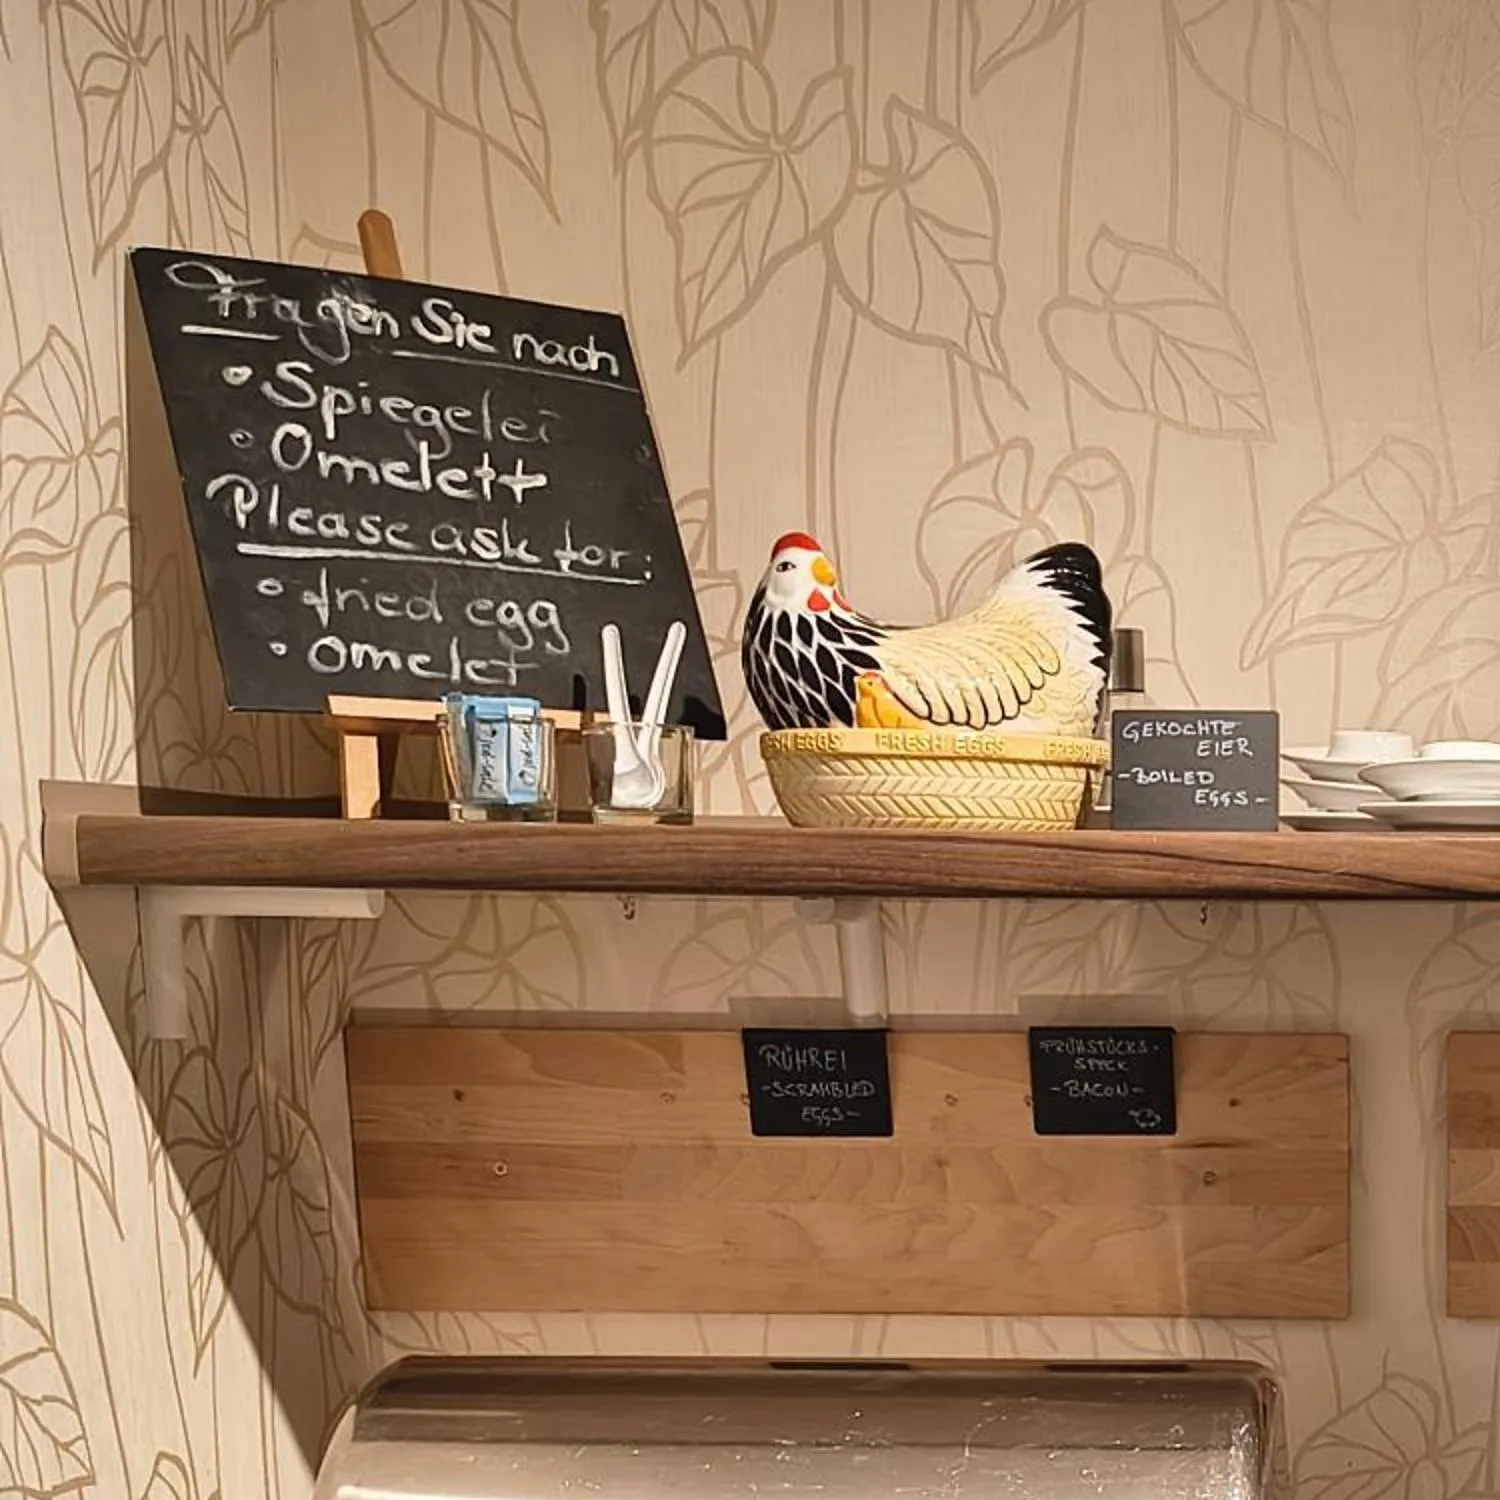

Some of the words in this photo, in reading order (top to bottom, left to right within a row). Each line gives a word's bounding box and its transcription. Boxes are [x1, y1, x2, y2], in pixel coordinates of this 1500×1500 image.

[164, 260, 400, 365] Fragen
[410, 298, 497, 353] Sie
[512, 334, 620, 377] nach
[260, 360, 562, 460] Spiegelei
[271, 422, 548, 505] Omelett
[205, 473, 418, 552] Please
[431, 518, 542, 564] ask
[303, 567, 443, 628] fried
[466, 599, 571, 655] egg
[1122, 719, 1242, 743] GEKOCHTE
[1196, 737, 1253, 757] EIER
[760, 1043, 847, 1072] RÜHREI
